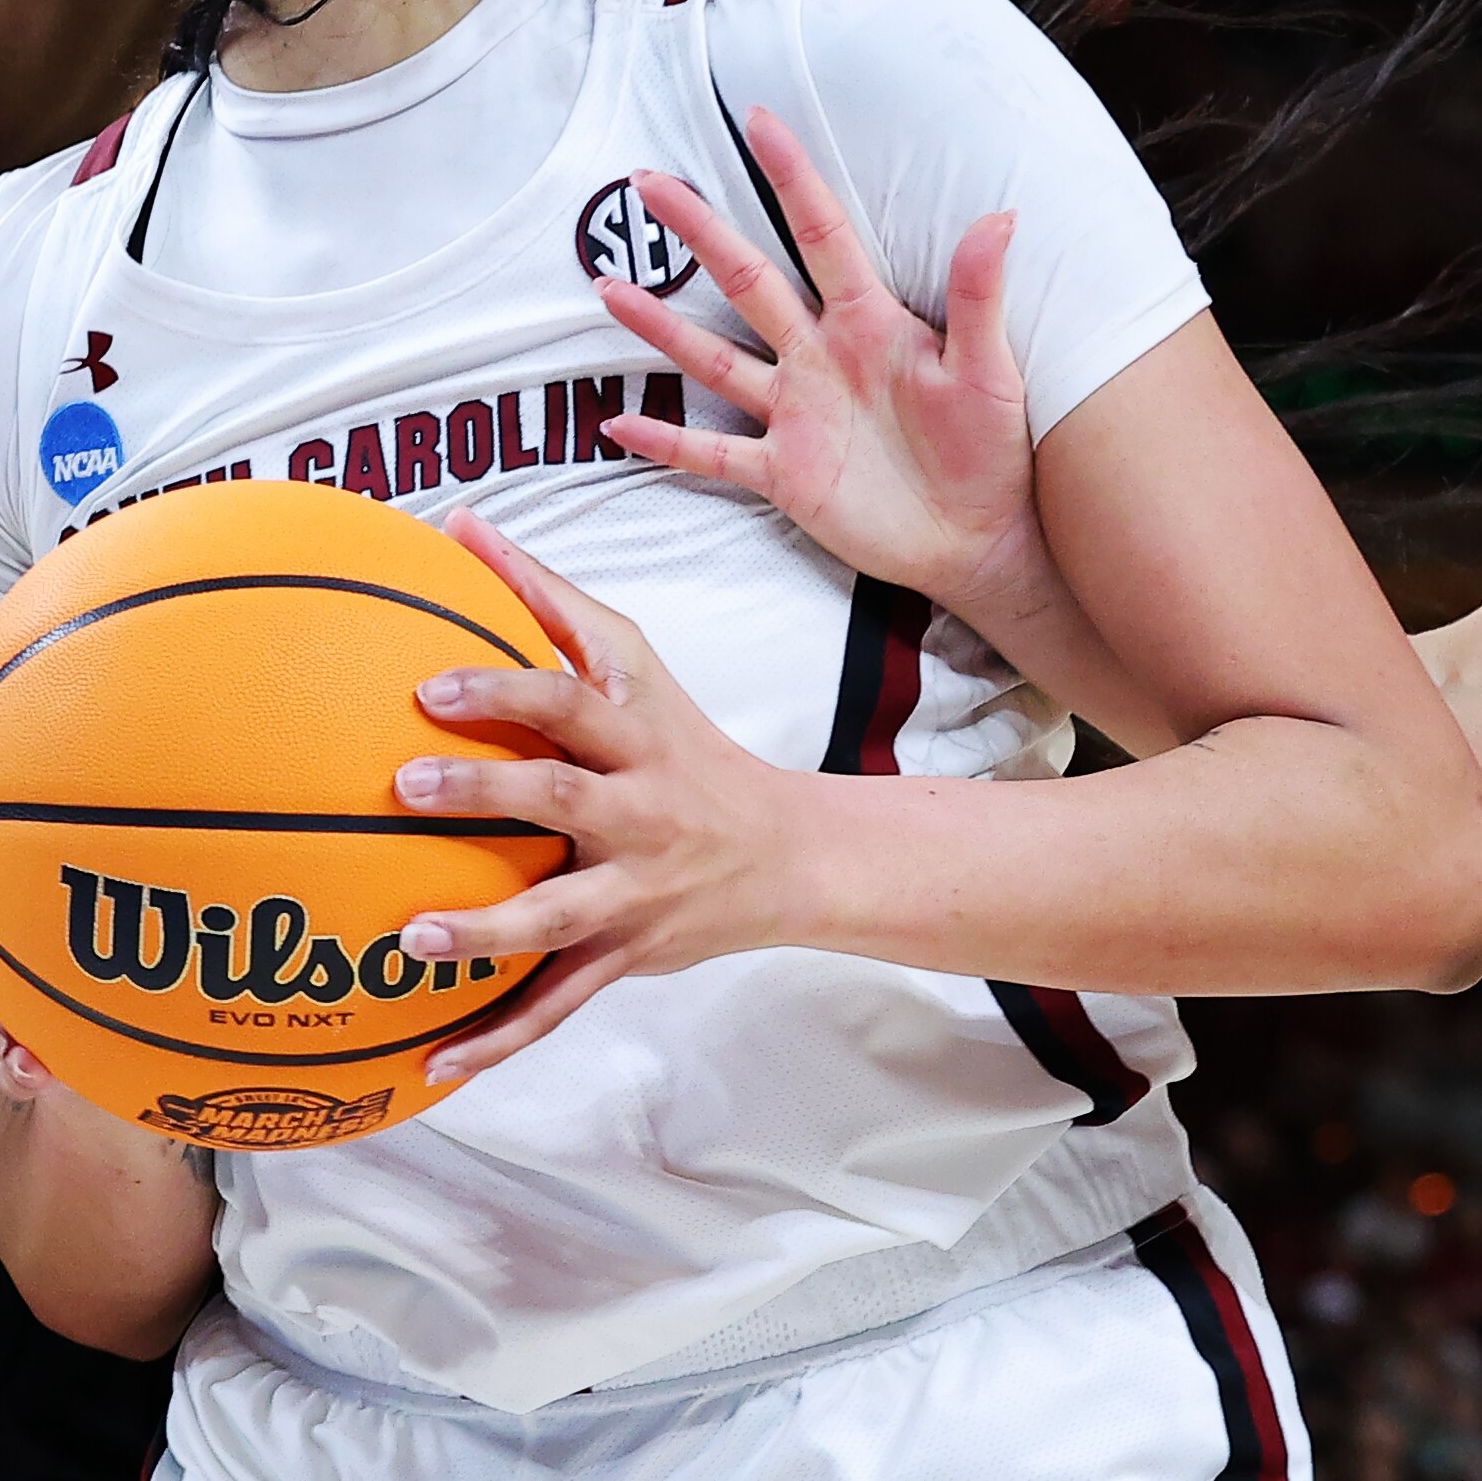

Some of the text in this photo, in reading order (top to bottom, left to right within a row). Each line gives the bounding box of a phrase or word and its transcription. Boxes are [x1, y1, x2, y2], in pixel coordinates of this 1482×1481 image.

[287, 371, 686, 502] CAROLINA
[52, 447, 118, 483] NCAA
[209, 1009, 355, 1029] EVO NXT
[197, 1105, 330, 1128] MARCH
